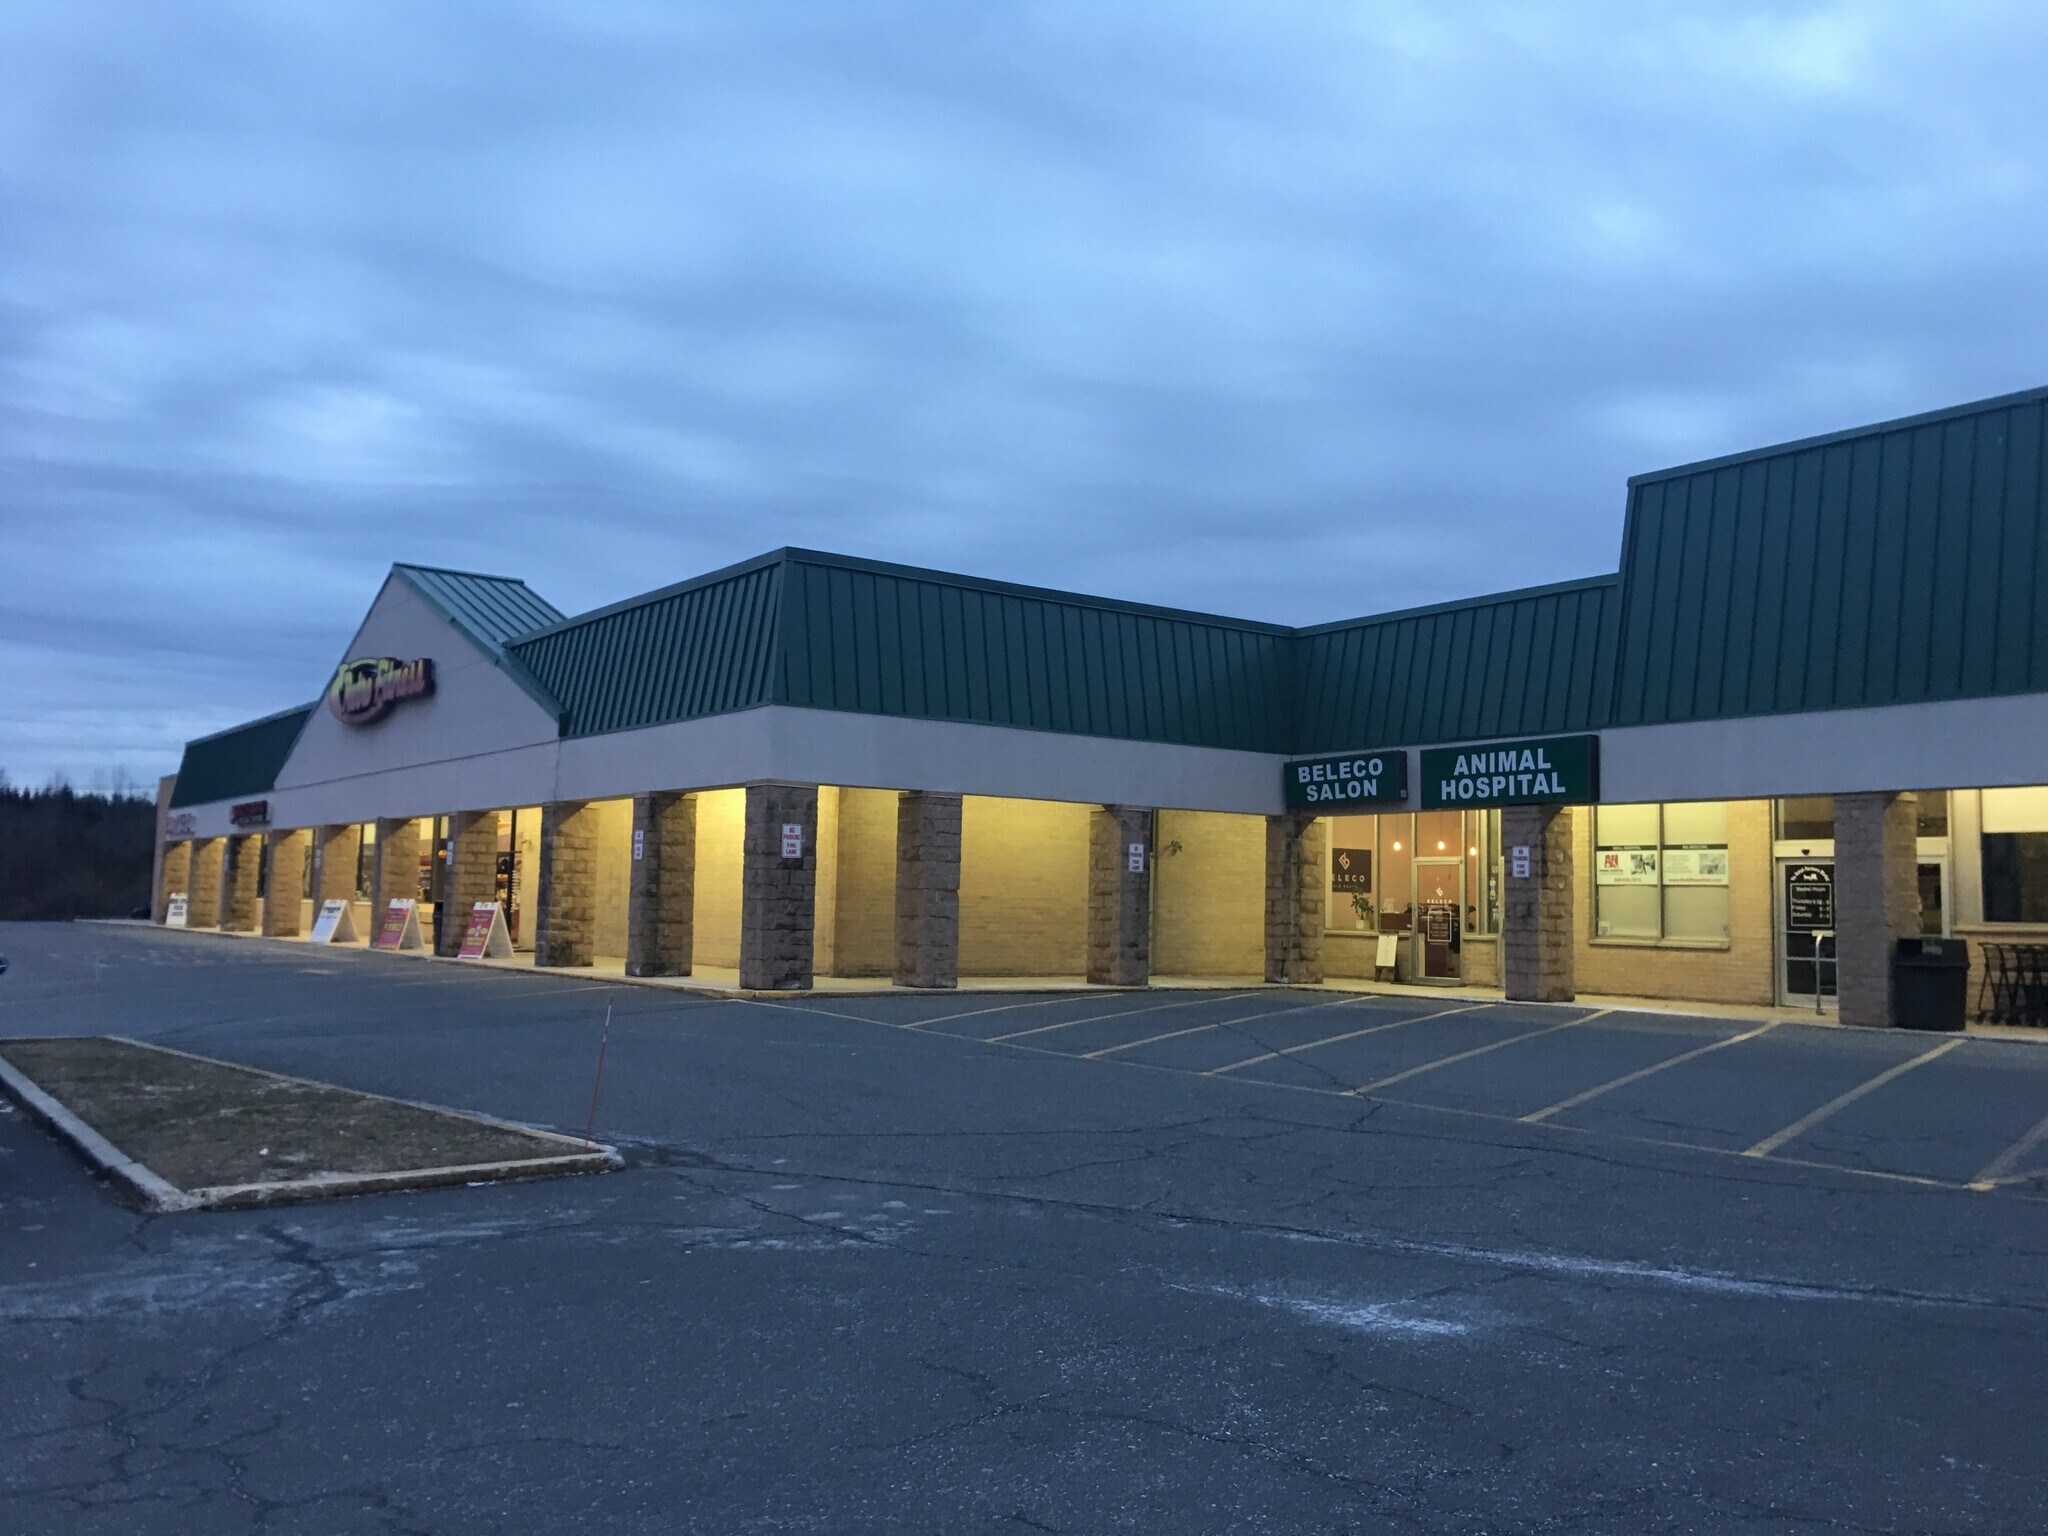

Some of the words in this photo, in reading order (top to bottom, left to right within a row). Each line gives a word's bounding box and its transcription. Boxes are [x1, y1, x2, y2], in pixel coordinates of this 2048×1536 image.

[1297, 758, 1383, 783] BELECO
[1453, 748, 1552, 776] ANIMAL
[1306, 778, 1377, 802] SALON
[1441, 771, 1566, 800] HOSPITAL
[789, 826, 796, 834] NO
[1332, 873, 1365, 883] ELECO
